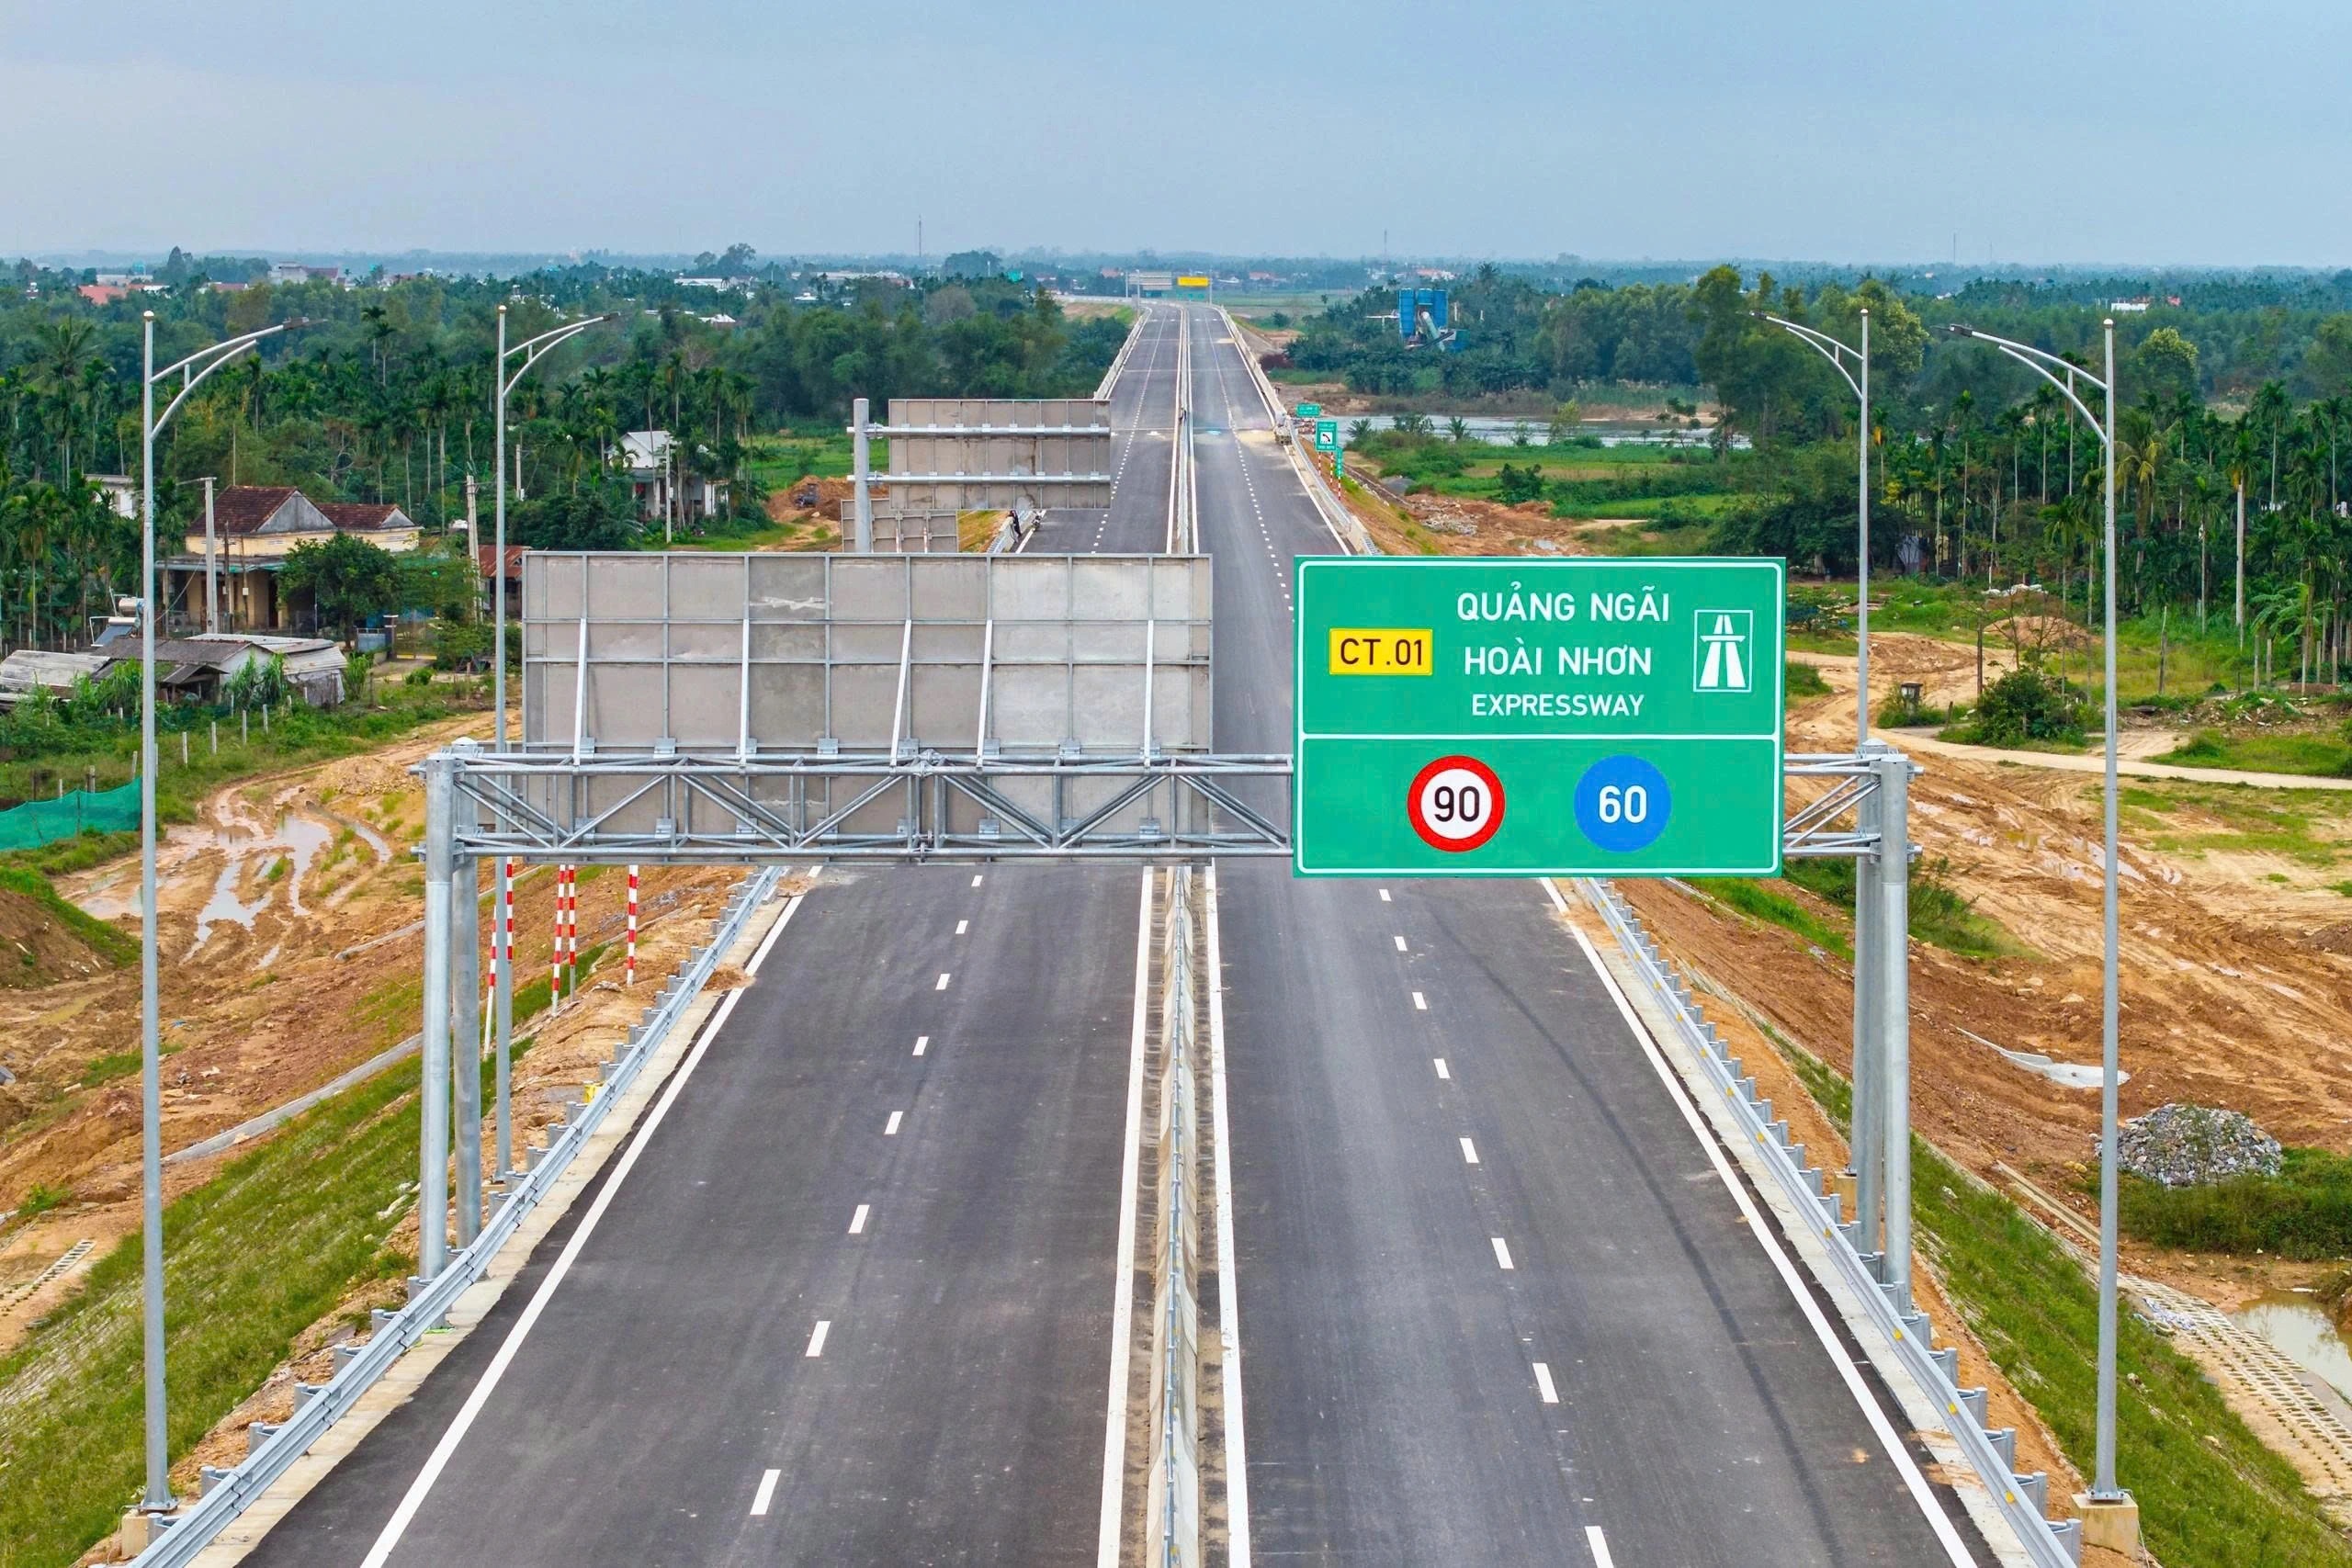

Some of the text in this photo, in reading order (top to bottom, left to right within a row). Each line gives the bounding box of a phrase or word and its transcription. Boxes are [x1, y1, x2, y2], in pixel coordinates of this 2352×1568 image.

[1457, 581, 1669, 622] QUẢNG NGÃI
[1340, 637, 1422, 666] CT.01
[1464, 637, 1652, 675] HOÀI NHƠN
[1472, 694, 1645, 716] EXPRESSWAY
[1434, 785, 1481, 822] 90
[1599, 784, 1647, 824] 60
